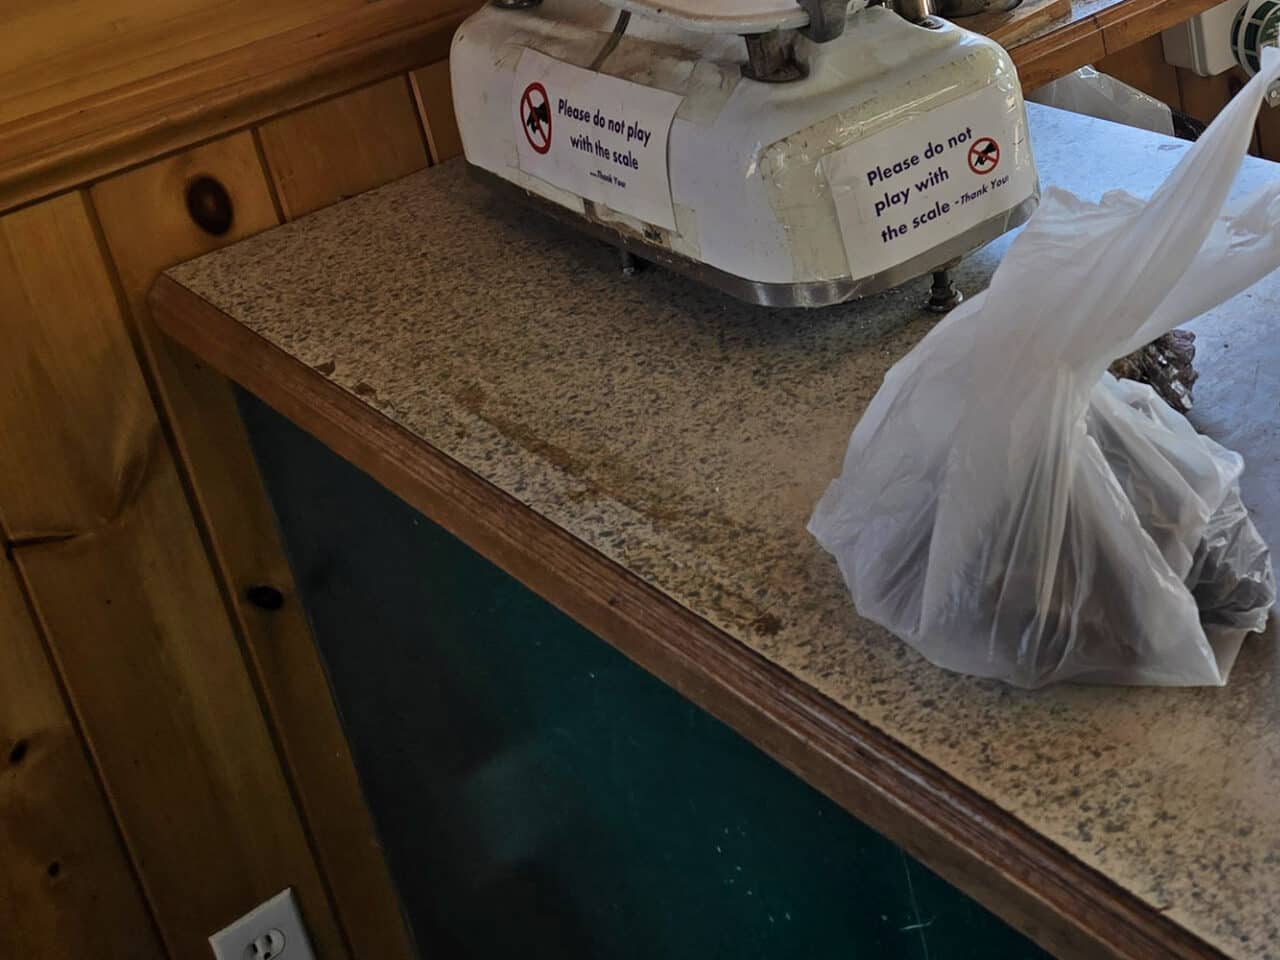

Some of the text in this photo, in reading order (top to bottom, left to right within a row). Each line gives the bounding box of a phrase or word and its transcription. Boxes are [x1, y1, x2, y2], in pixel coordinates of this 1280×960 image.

[558, 98, 652, 148] Please do not play
[570, 134, 639, 170] with the scale
[867, 127, 973, 186] Please do not
[874, 166, 950, 217] play with
[881, 221, 908, 243] the
[912, 200, 951, 230] scale
